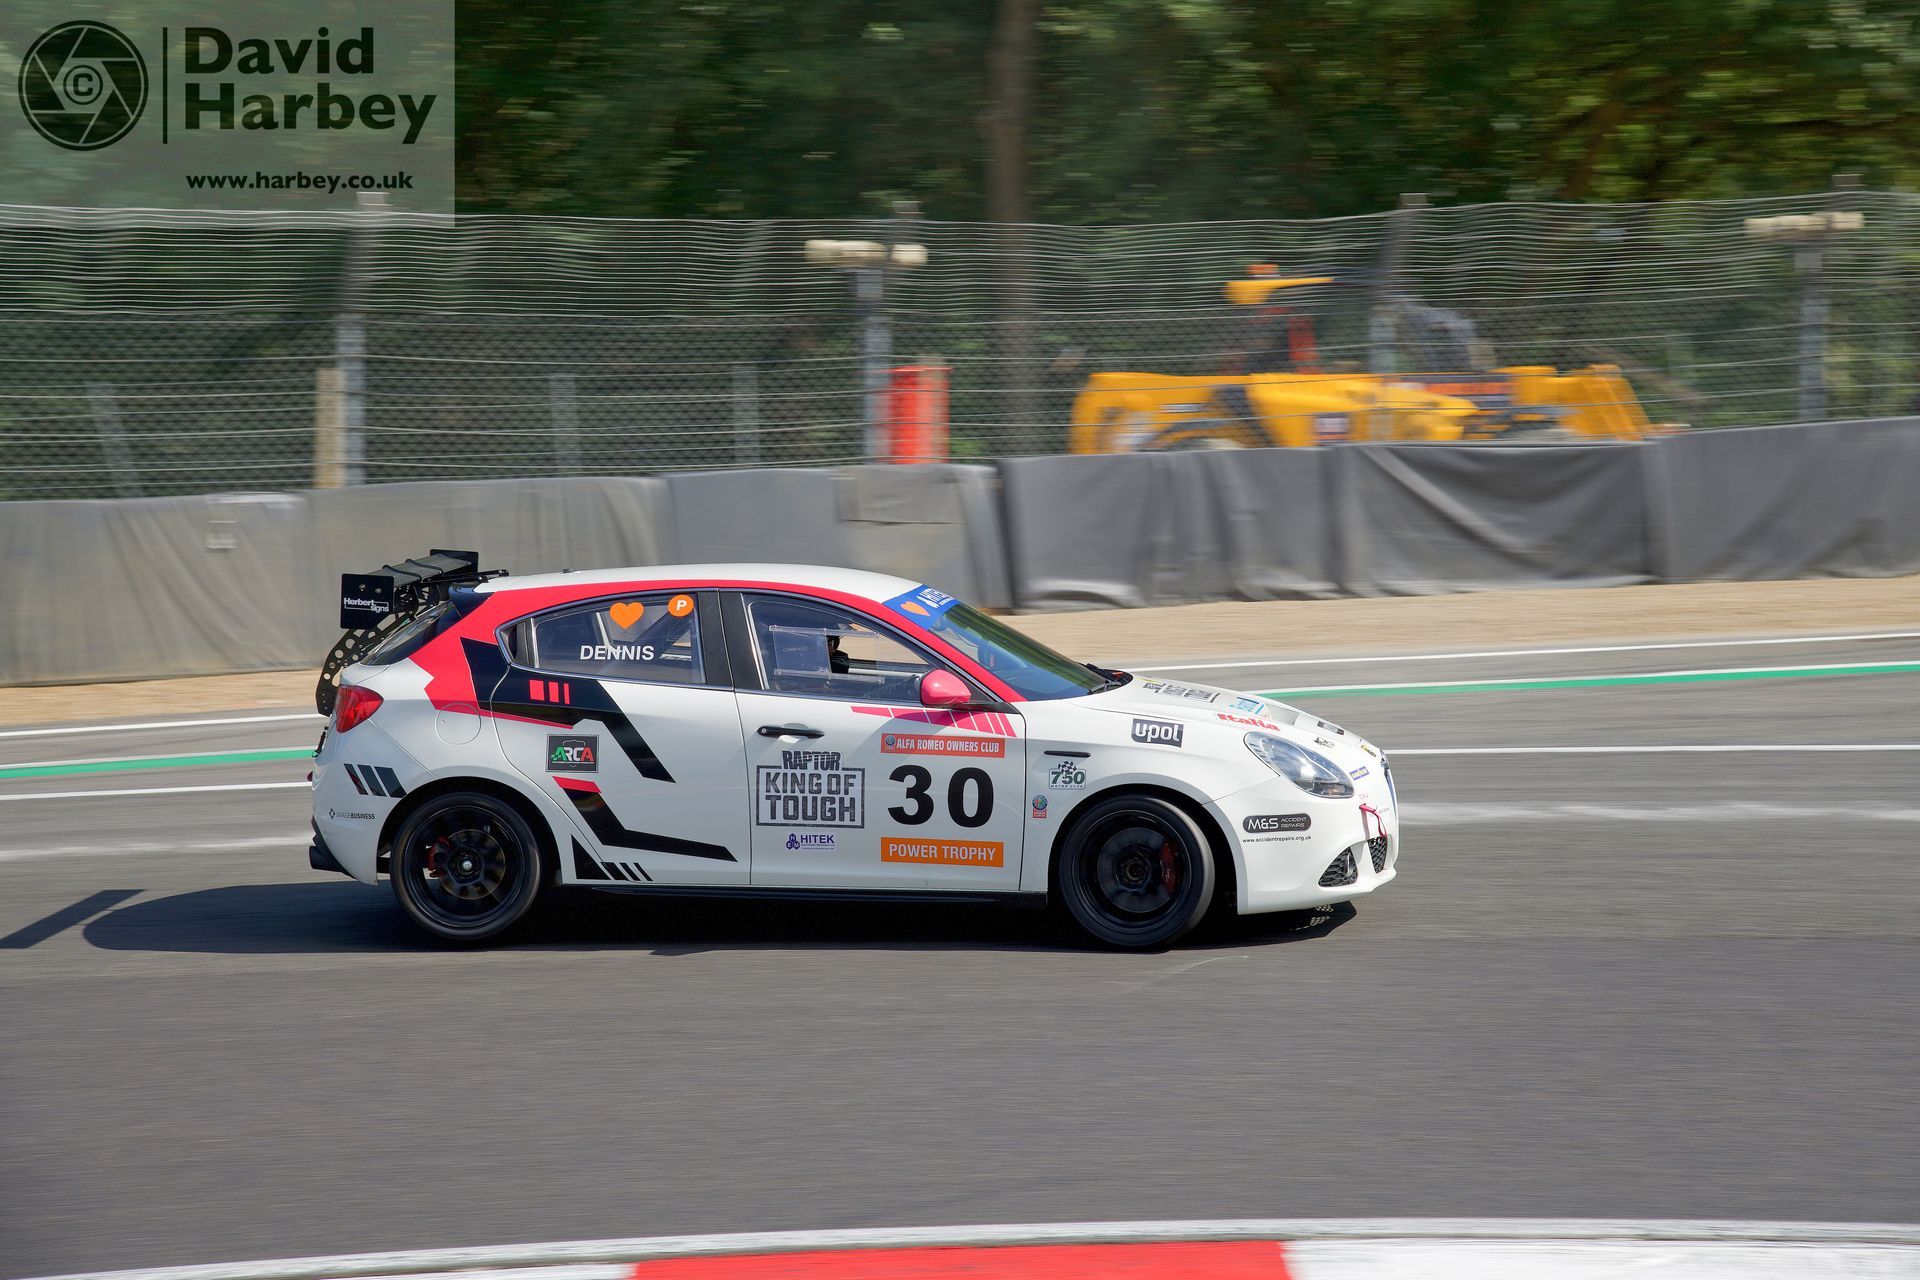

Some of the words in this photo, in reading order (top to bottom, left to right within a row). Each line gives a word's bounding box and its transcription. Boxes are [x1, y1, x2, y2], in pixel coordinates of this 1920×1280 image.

[343, 597, 375, 606] Herbert
[676, 599, 688, 611] P
[580, 645, 655, 661] DENNIS
[896, 738, 915, 749] ALFA
[917, 739, 945, 751] ROMEO
[946, 741, 979, 752] OWNERS
[980, 742, 1000, 753] CLUB
[551, 746, 595, 762] ARCA
[782, 750, 841, 771] RAPTOR
[765, 772, 822, 794] KING
[827, 773, 857, 795] OF
[1051, 771, 1085, 785] 750
[887, 764, 994, 828] 30
[765, 794, 856, 822] TOUGH
[1247, 817, 1279, 830] M&S
[800, 834, 835, 844] HITEK
[889, 843, 938, 859] POWER
[942, 845, 996, 861] TROPHY
